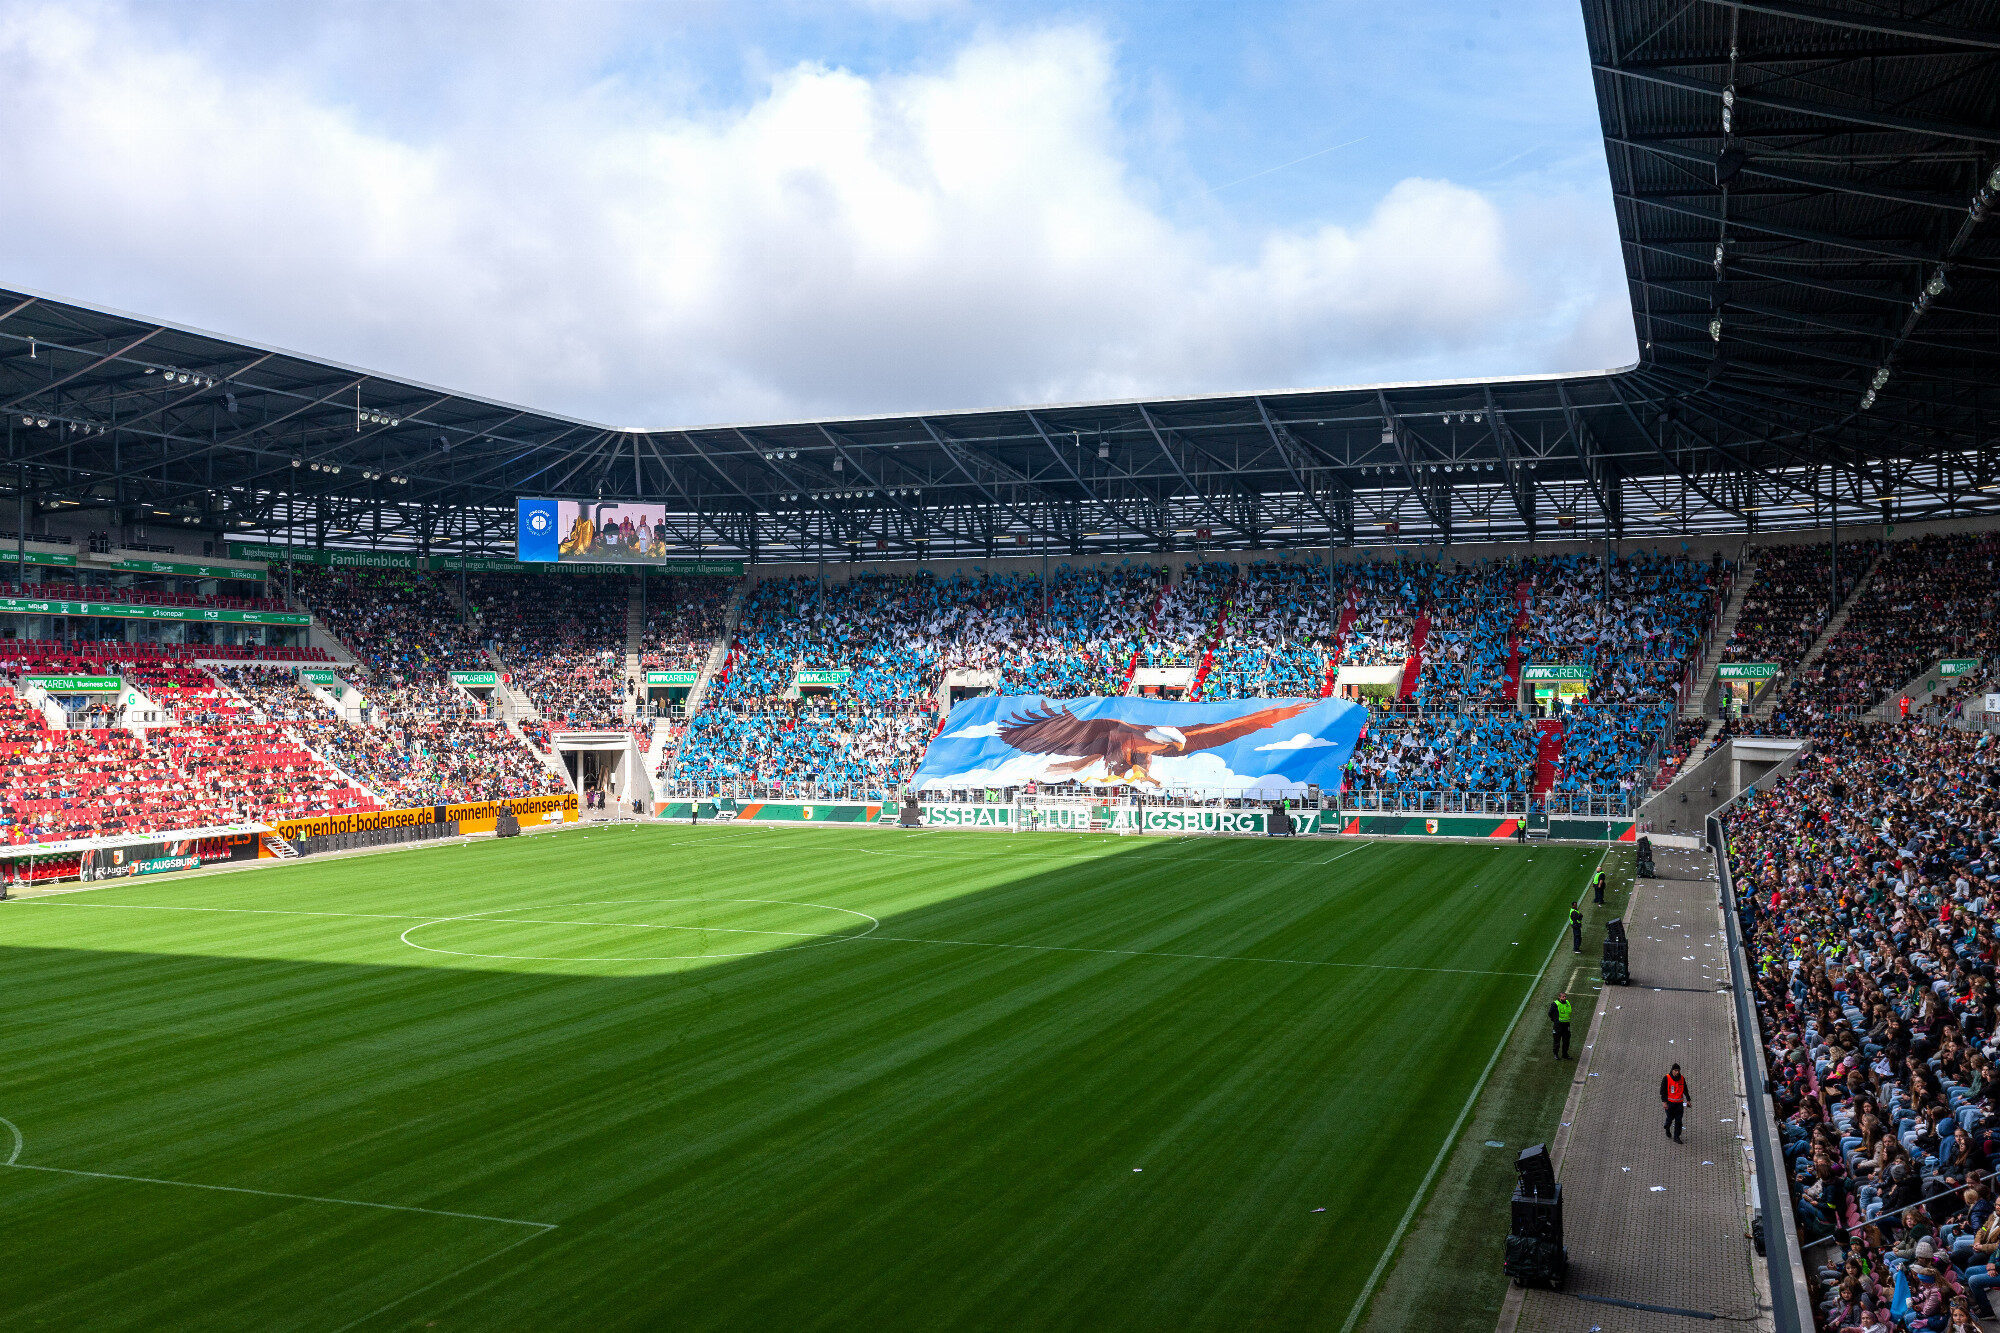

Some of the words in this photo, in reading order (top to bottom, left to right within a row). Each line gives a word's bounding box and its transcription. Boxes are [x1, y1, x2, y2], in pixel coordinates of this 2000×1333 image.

[877, 540, 886, 549] K
[241, 547, 279, 560] Augsburger
[280, 548, 314, 561] Allemeine
[330, 553, 411, 568] Familienblock
[486, 561, 524, 571] Allgemeine
[543, 563, 626, 574] Familienblock
[656, 565, 694, 575] Augsburger
[696, 565, 735, 574] Allgemeine
[76, 680, 103, 688] Business
[103, 680, 118, 688] Club
[335, 687, 343, 698] H
[128, 693, 136, 706] G
[1111, 810, 1255, 833] AUGSBURG
[139, 861, 151, 872] FC
[152, 856, 199, 871] AUGSBURG
